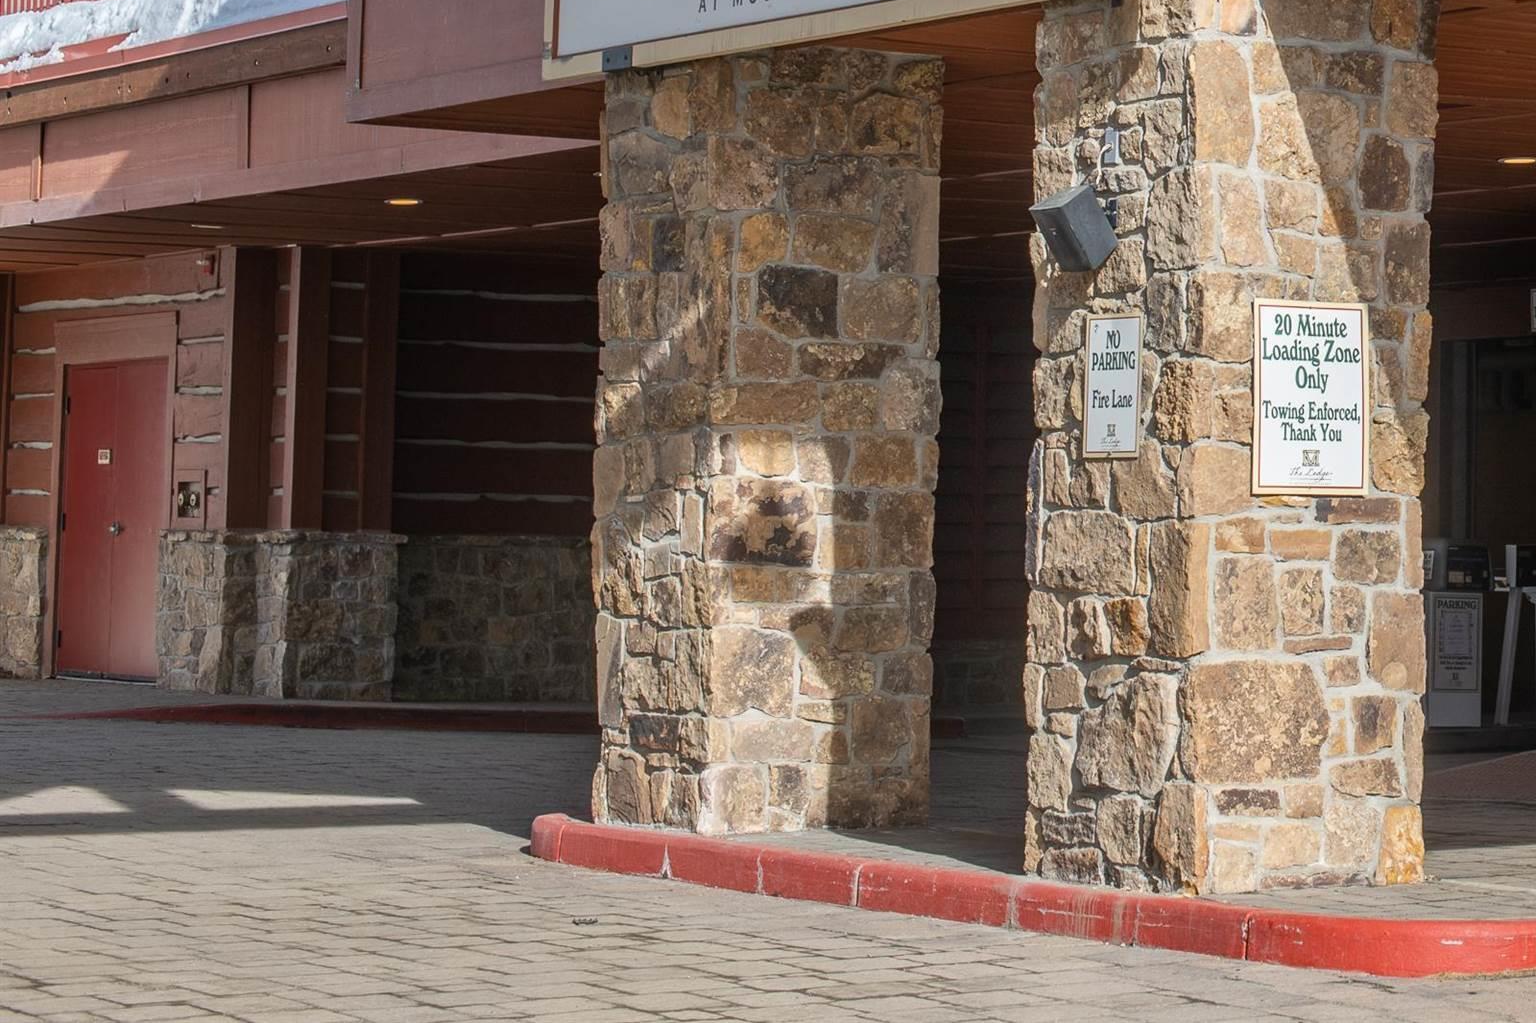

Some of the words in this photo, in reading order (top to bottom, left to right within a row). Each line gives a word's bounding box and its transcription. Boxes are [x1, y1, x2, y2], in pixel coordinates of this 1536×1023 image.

[1274, 313, 1292, 336] 20
[1296, 313, 1348, 338] Minute
[1106, 329, 1121, 349] NO
[1091, 350, 1136, 371] PARKING
[1262, 337, 1321, 367] Loading
[1323, 339, 1361, 364] Zone
[1295, 365, 1329, 394] Only
[1092, 389, 1110, 409] Fire
[1111, 388, 1133, 408] Lane
[1262, 400, 1306, 424] Towing
[1307, 401, 1361, 425] Enforced,
[1280, 421, 1317, 442] Thank
[1320, 423, 1343, 442] You
[1437, 599, 1478, 609] PARKING
